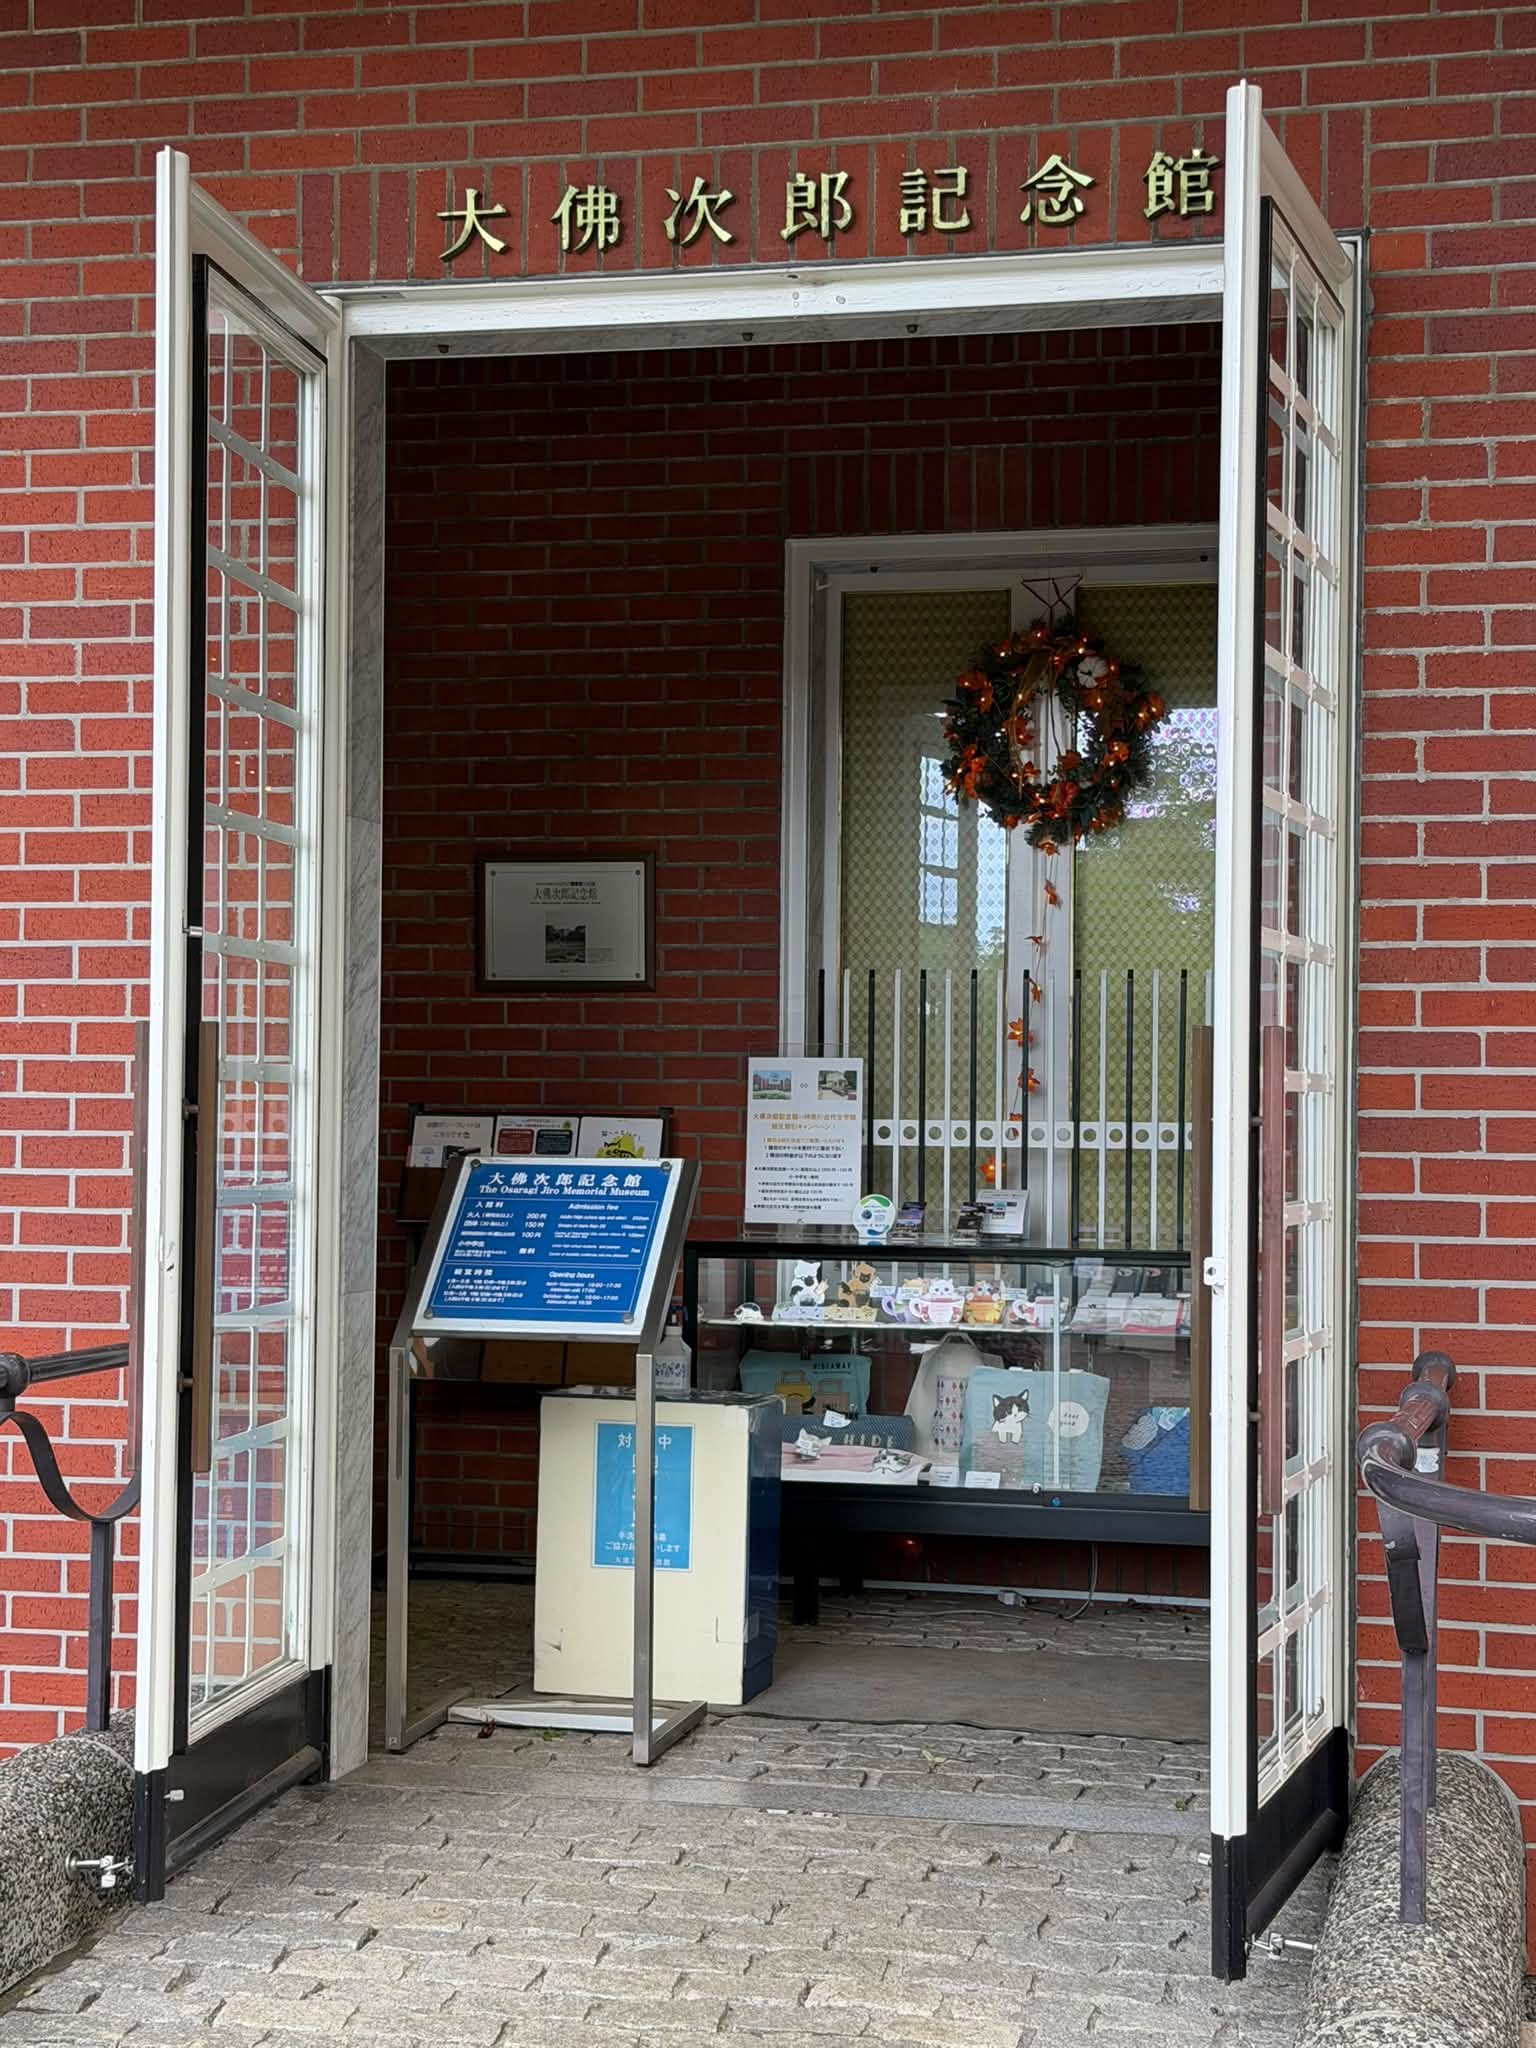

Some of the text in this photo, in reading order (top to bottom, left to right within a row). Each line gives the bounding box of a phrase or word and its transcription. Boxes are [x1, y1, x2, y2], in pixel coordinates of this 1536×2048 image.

[436, 147, 1221, 262] 大佛次郎記念館
[487, 1172, 642, 1188] 大佛次郎記念館
[479, 1185, 650, 1198] The Osaragi Jiro Memorial Museum
[617, 1431, 672, 1451] 対中
[843, 1433, 896, 1449] HIDE
